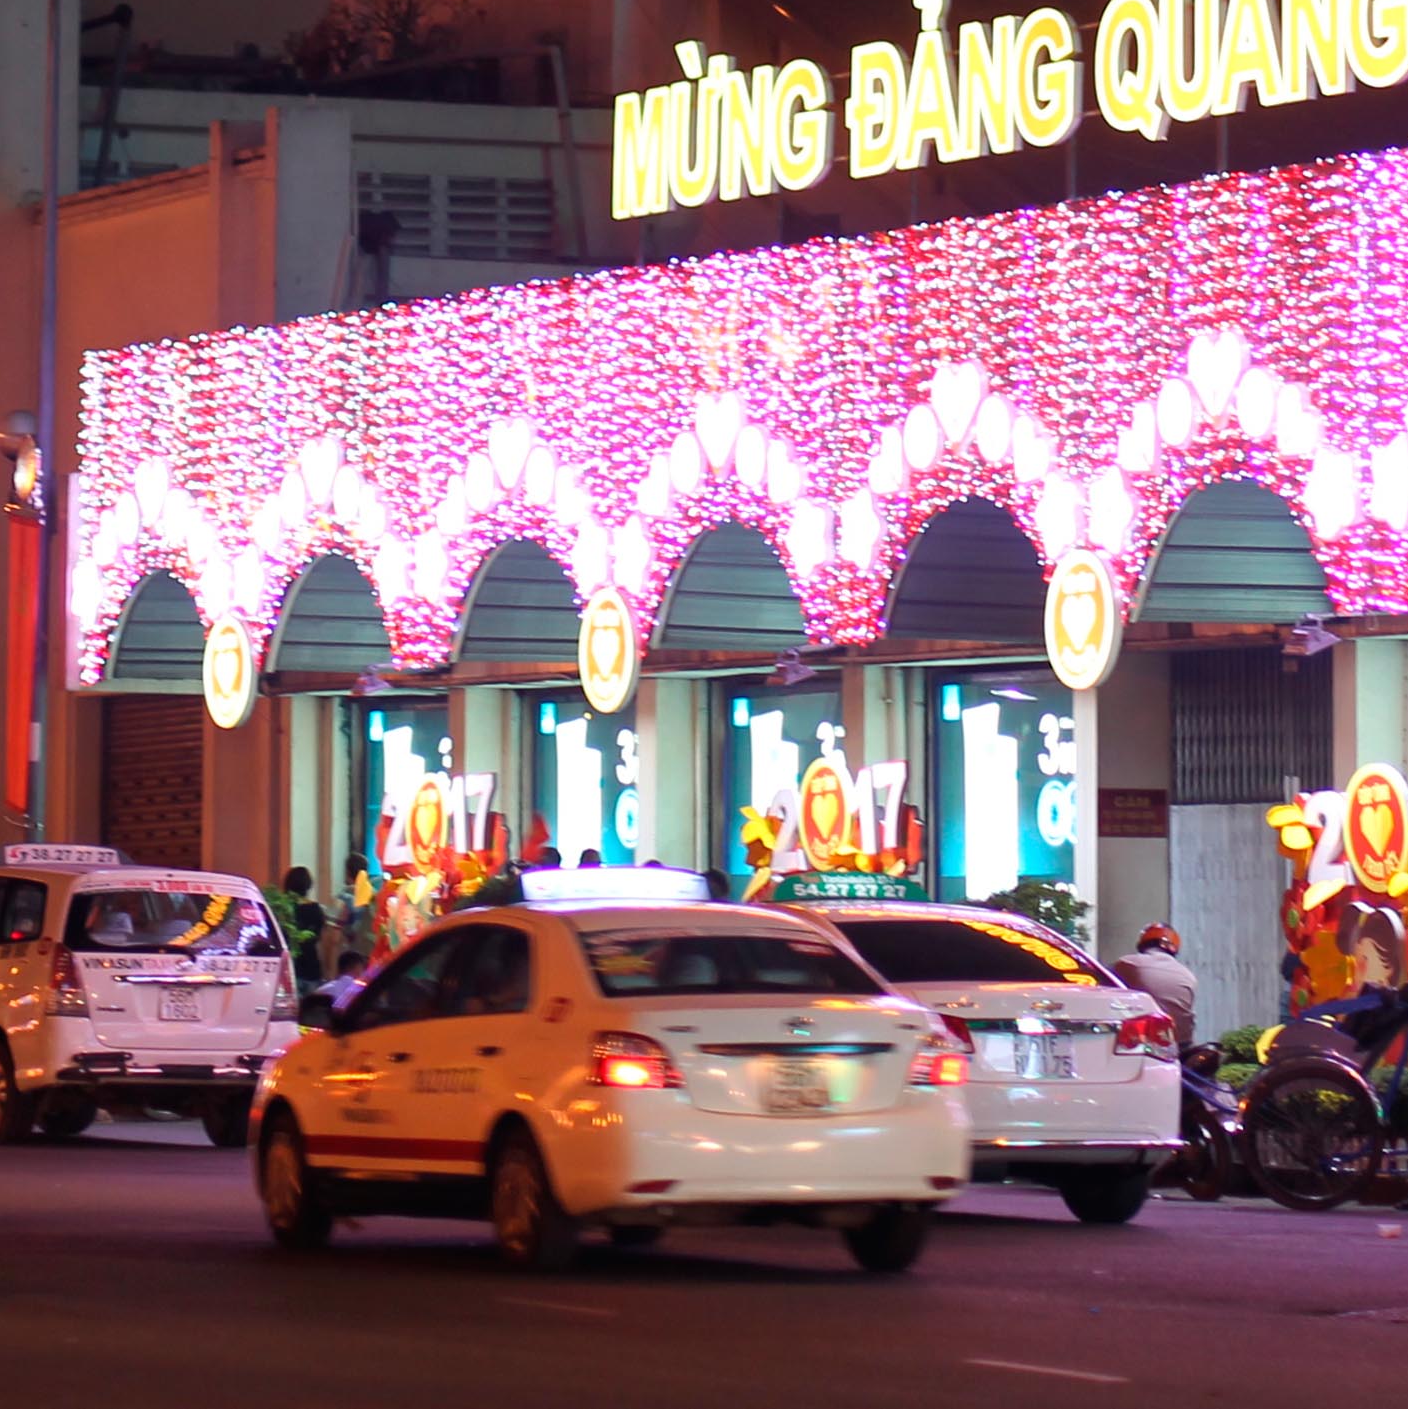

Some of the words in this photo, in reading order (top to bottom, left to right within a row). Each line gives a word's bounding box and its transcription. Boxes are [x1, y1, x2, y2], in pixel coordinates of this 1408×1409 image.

[611, 39, 834, 220] MỪNG
[854, 883, 878, 897] 27
[883, 884, 907, 898] 27
